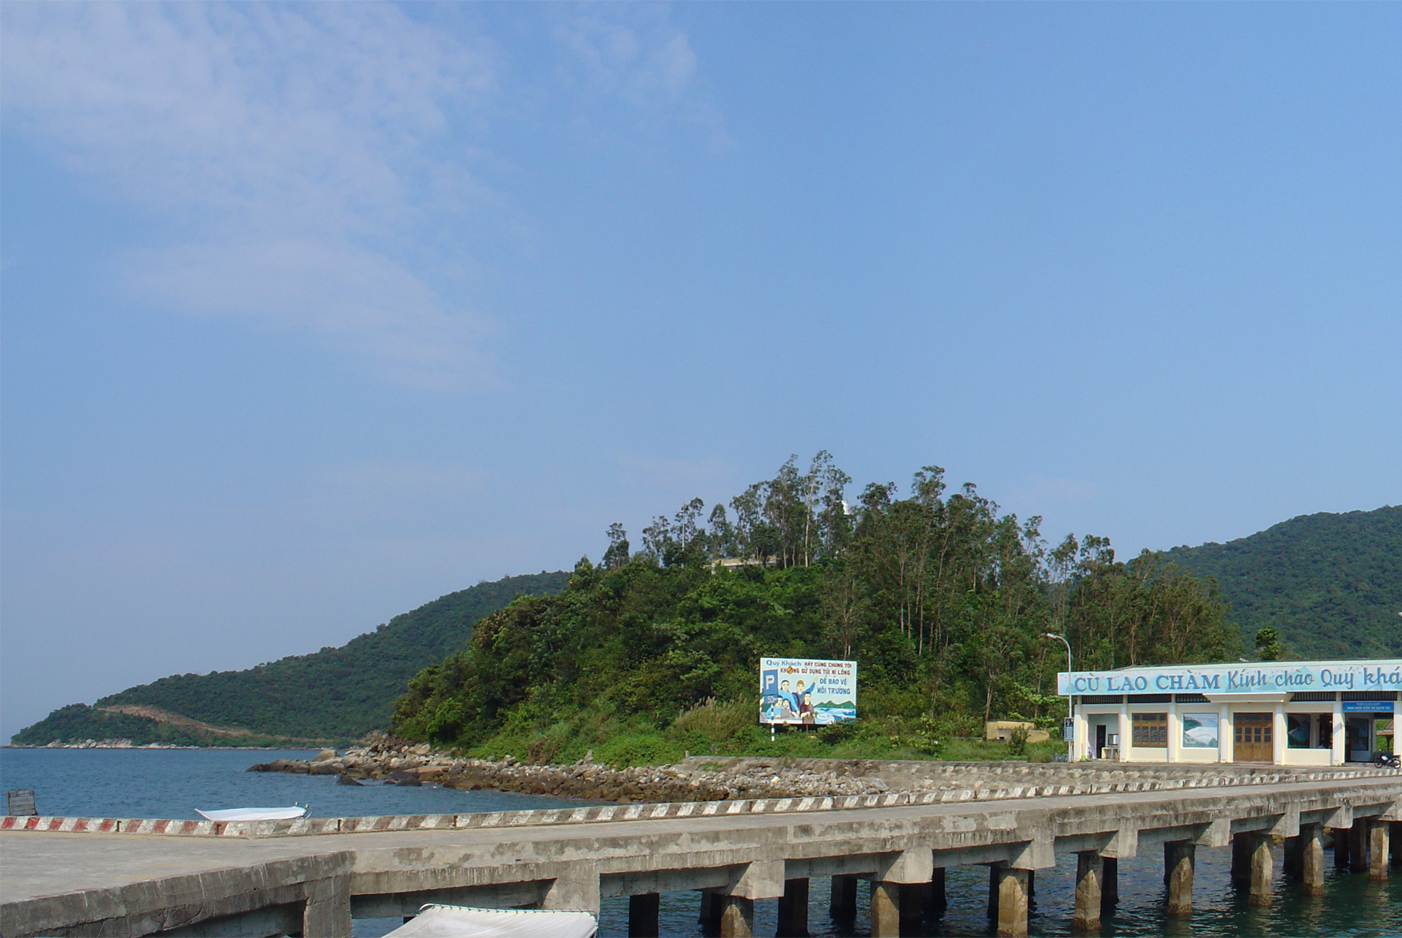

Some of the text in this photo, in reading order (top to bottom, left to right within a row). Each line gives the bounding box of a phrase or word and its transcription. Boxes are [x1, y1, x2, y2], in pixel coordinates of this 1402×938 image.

[766, 675, 775, 690] P
[1074, 672, 1100, 692] CÙ
[1106, 675, 1148, 692] LAO
[1155, 669, 1221, 690] CHÀM
[1227, 668, 1267, 690] Kính
[1275, 668, 1314, 687] chào
[1320, 666, 1354, 689] Quý
